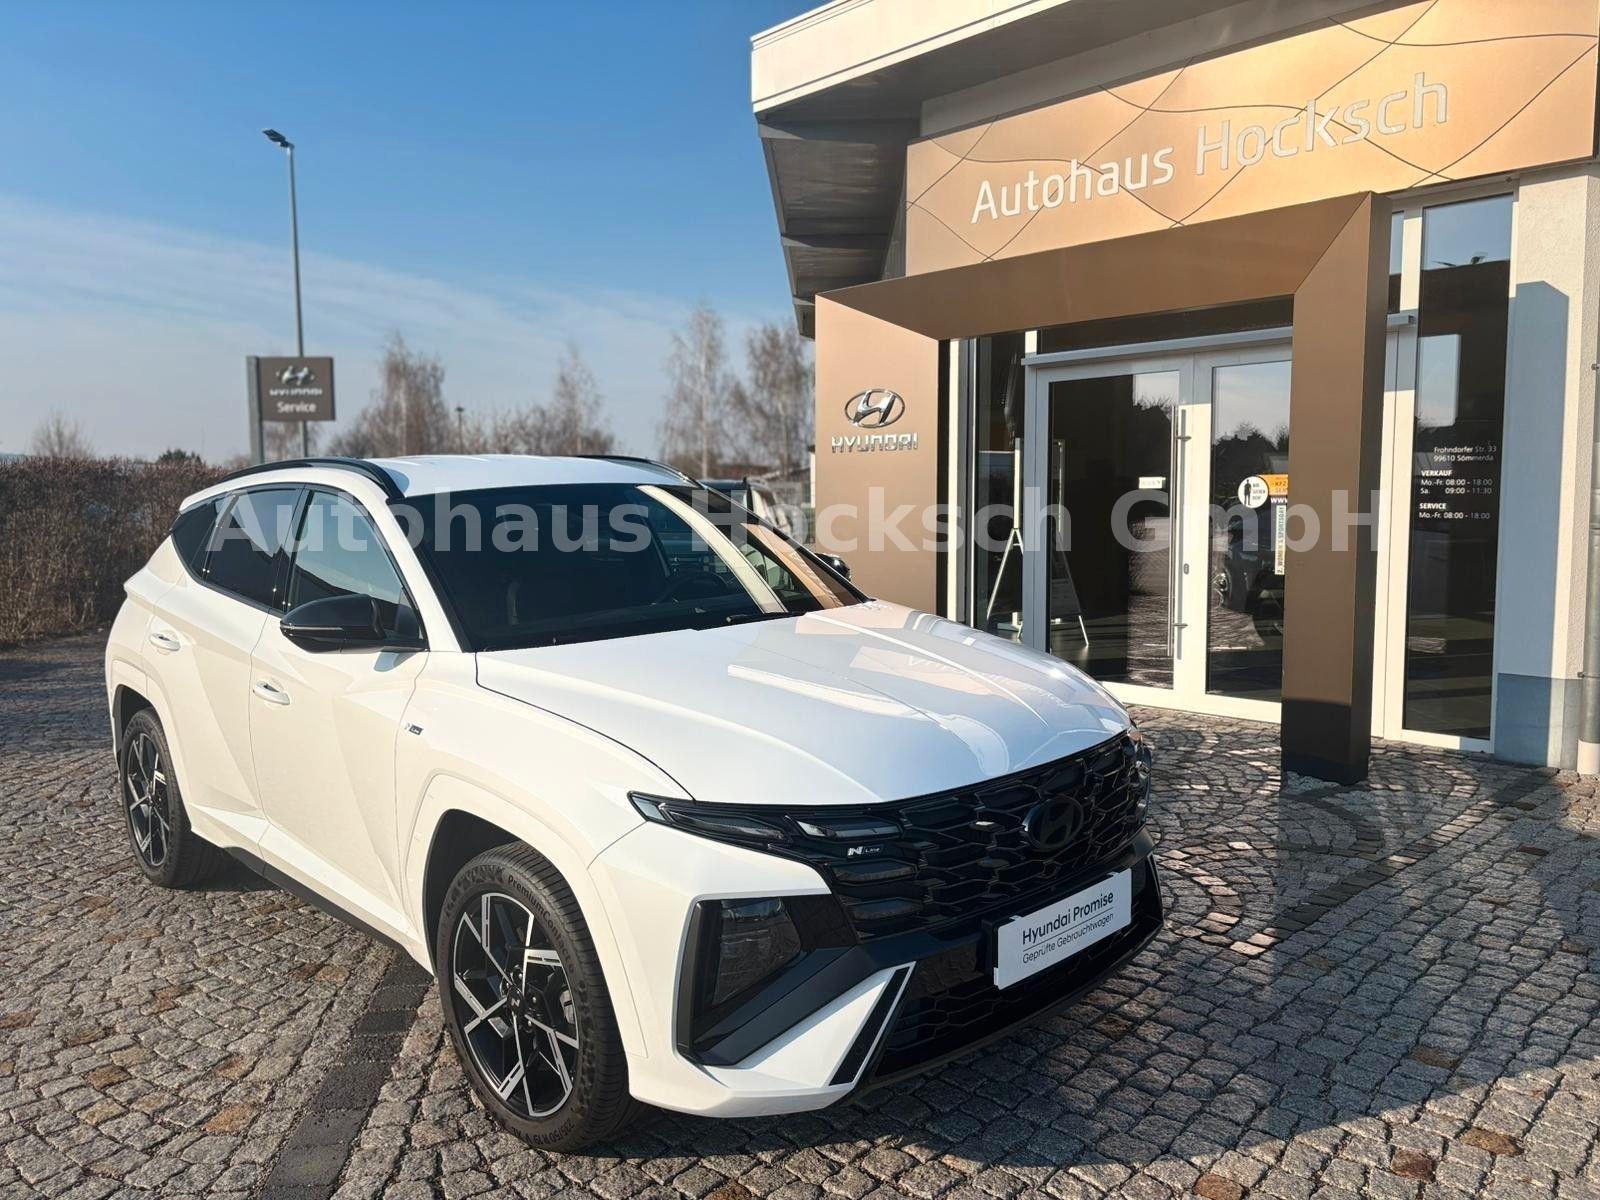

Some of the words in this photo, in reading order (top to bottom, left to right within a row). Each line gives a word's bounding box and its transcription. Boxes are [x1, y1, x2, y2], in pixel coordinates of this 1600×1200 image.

[969, 145, 1176, 224] Autohaus
[1195, 71, 1448, 176] Hocksch
[276, 401, 317, 413] Service
[831, 432, 919, 454] HYUNDAI
[1433, 454, 1455, 462] 99610
[1022, 909, 1071, 945] Hyundai
[1073, 891, 1114, 922] Promise
[1022, 941, 1056, 964] Geprüfte
[1057, 912, 1114, 948] Gebrauchtwagen
